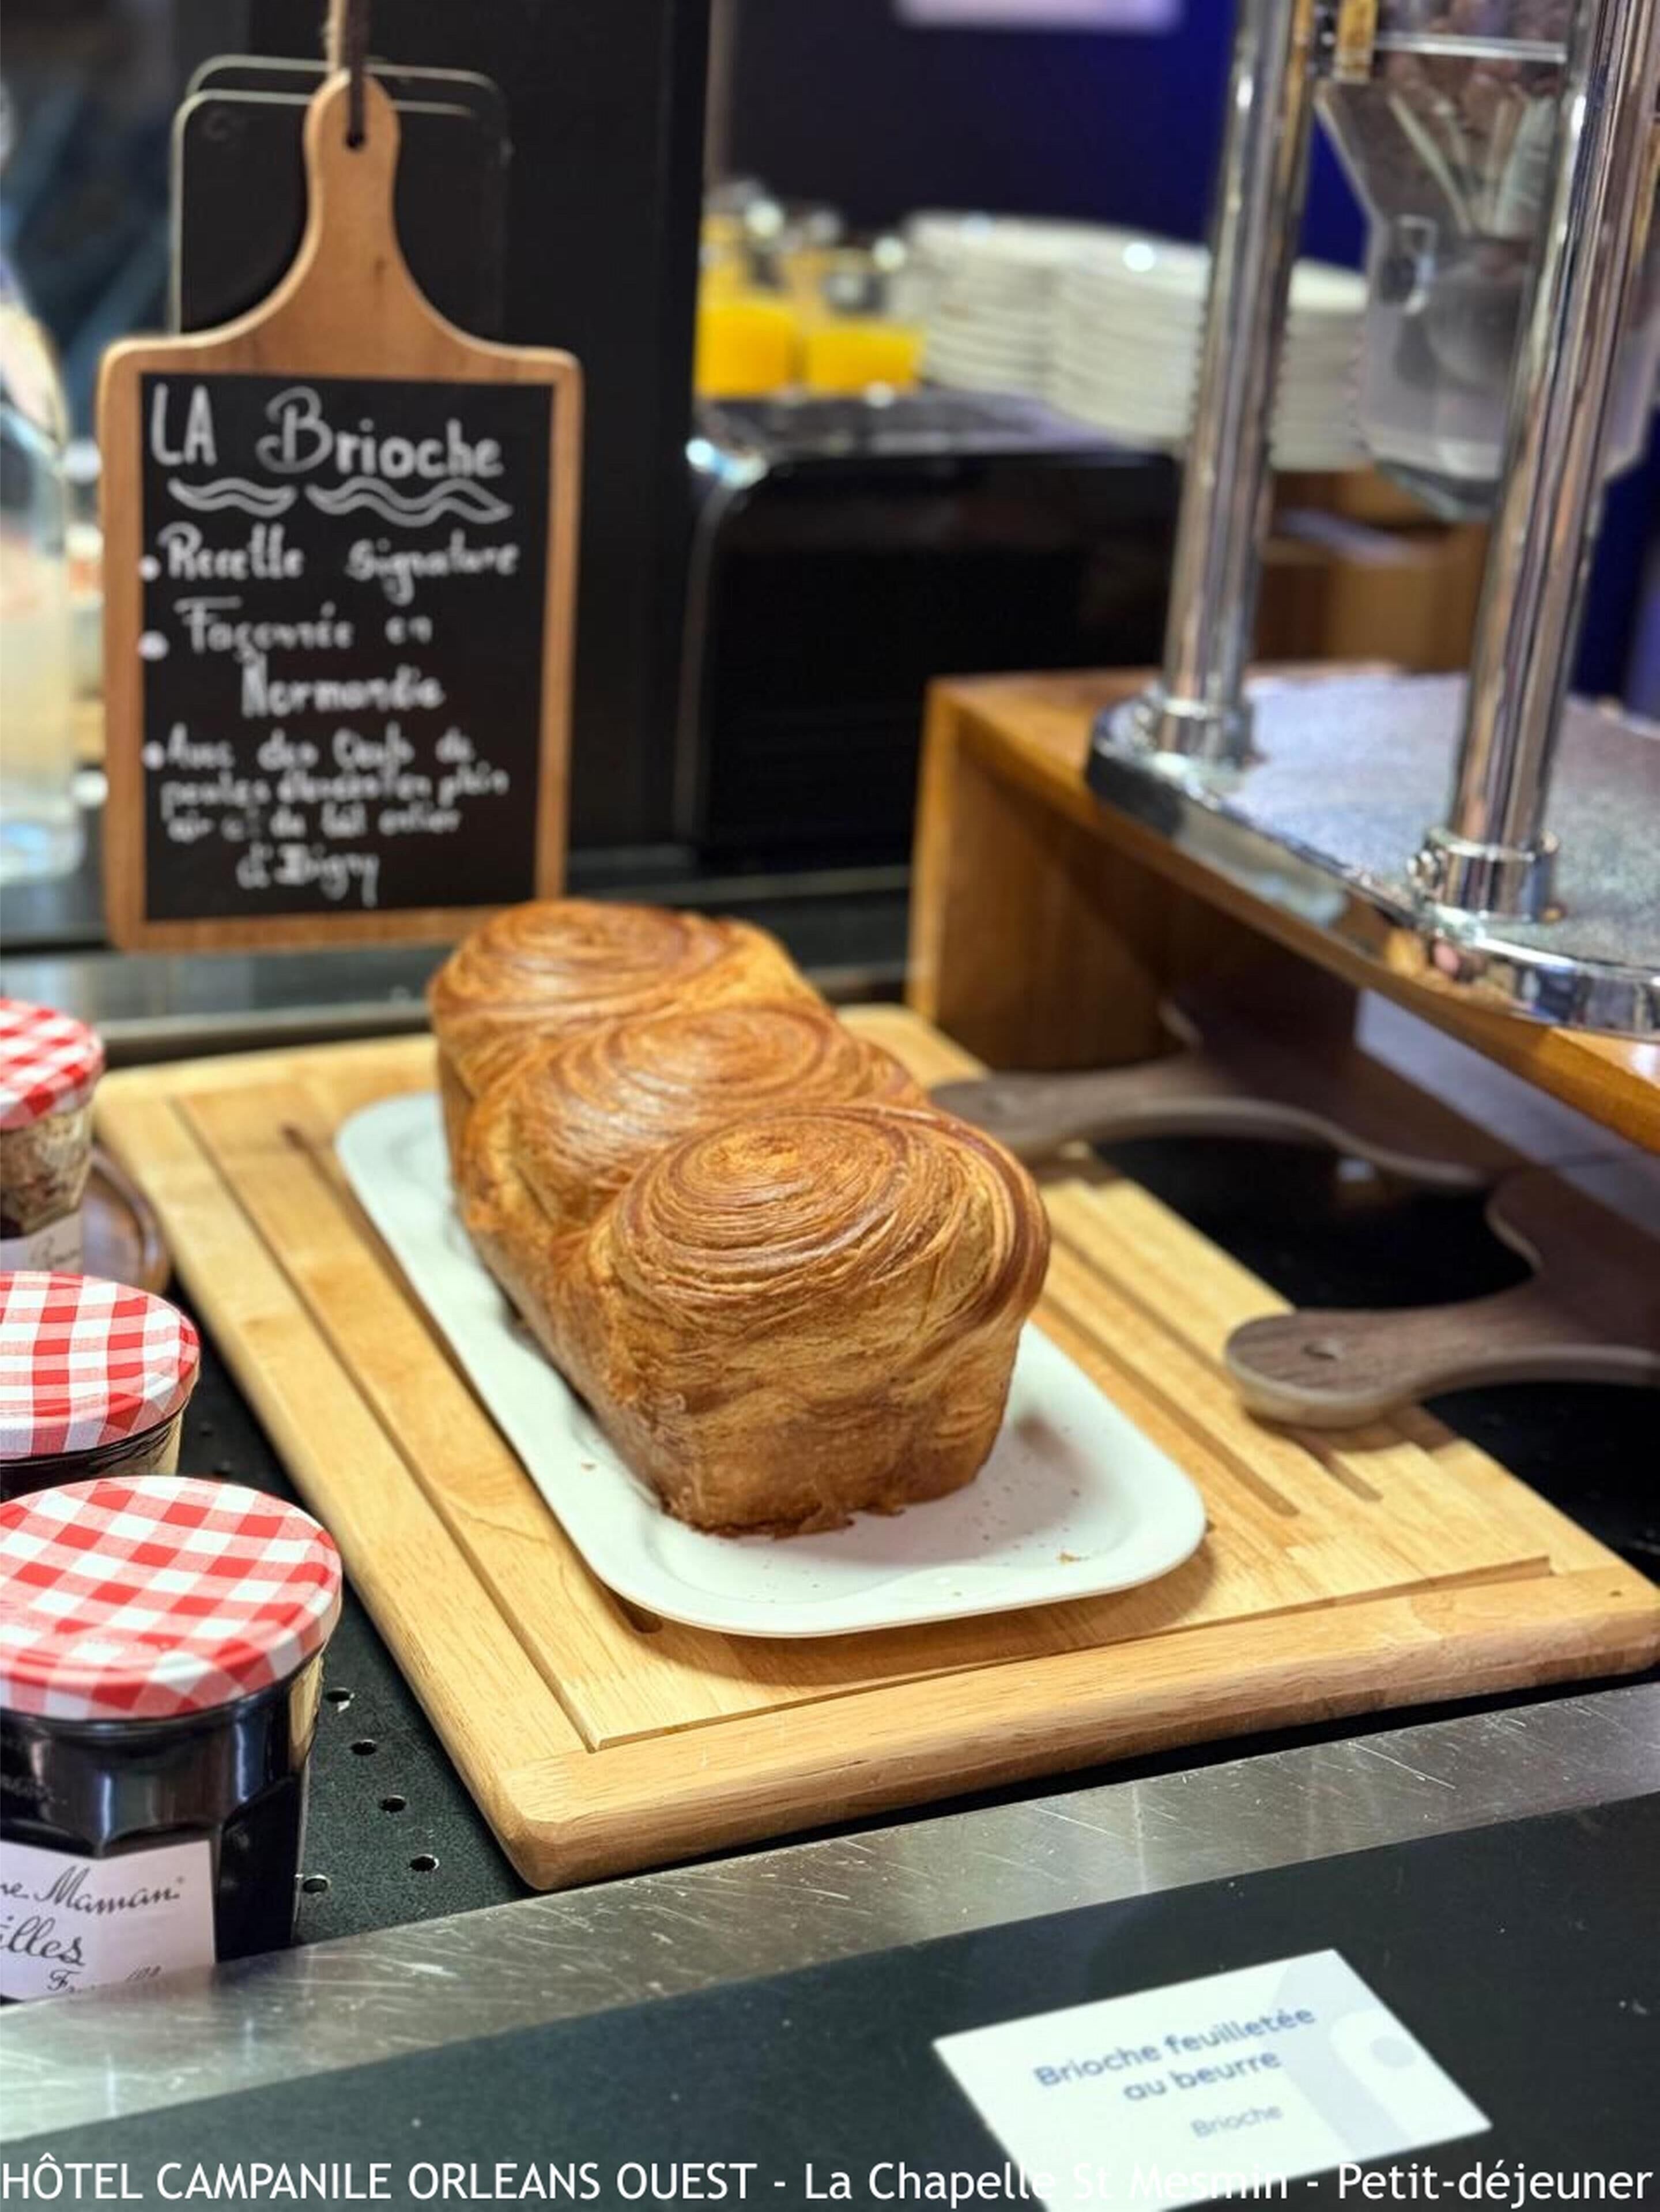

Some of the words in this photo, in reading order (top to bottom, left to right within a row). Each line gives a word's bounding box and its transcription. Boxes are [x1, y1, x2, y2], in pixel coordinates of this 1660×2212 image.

[151, 383, 217, 466] LA
[255, 386, 504, 478] Brioche
[346, 527, 520, 606] Signature
[1033, 2044, 1161, 2087] Brioche
[1164, 2007, 1316, 2055] feuilletée
[1123, 2078, 1169, 2103] au
[1171, 2050, 1281, 2089] beurre
[1191, 2104, 1283, 2137] Brioche
